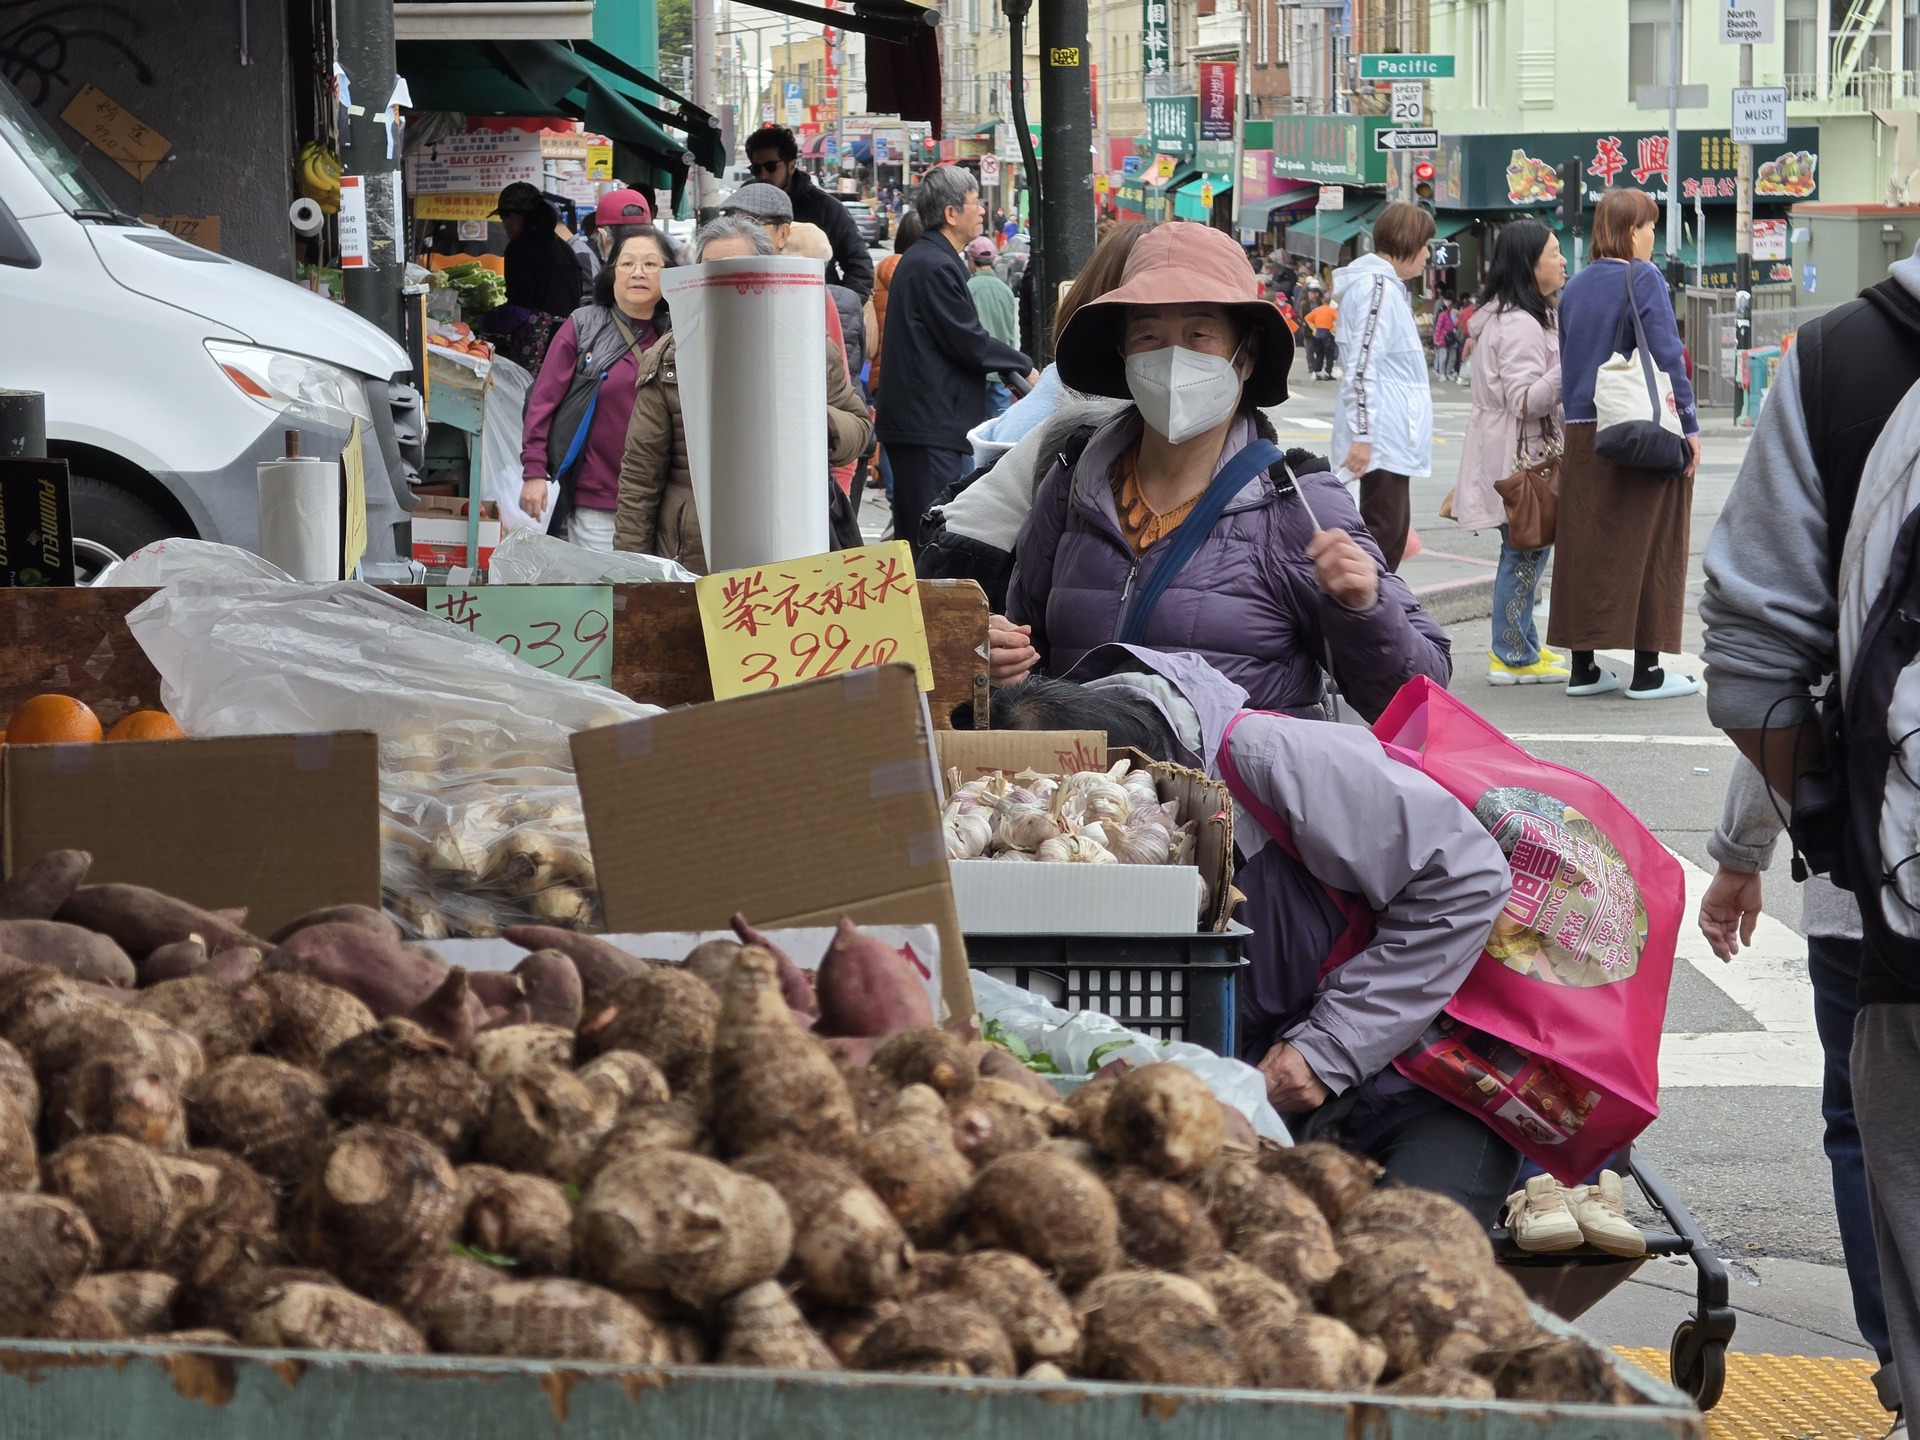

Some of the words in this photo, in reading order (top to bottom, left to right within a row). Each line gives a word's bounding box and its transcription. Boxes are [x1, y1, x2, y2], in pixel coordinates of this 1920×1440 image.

[1727, 10, 1755, 19] North
[1727, 19, 1758, 29] Beach
[1727, 29, 1762, 40] Garage
[1378, 60, 1438, 73] Pacific
[1737, 95, 1756, 104] LEFT
[1761, 94, 1783, 103] LANE
[1396, 103, 1420, 117] 20
[1744, 110, 1773, 120] MUST
[1394, 135, 1412, 144] ONE
[1415, 134, 1433, 144] WAY
[1735, 127, 1756, 136] TURN
[1761, 126, 1781, 135] LEFT
[450, 155, 470, 165] BAY
[473, 155, 507, 165] CRAFT
[1587, 135, 1669, 187] 華興
[1682, 177, 1738, 198] 食品公
[1372, 285, 1383, 310] TOMMY
[1364, 314, 1377, 346] HILFIGER
[1357, 347, 1369, 373] TOMMY
[1359, 407, 1367, 432] TOMMY
[38, 478, 60, 568] PUMMELO
[1537, 888, 1568, 934] HANG
[1595, 921, 1614, 947] 1050
[1608, 891, 1619, 919] Grant
[1555, 909, 1587, 951] 燕窩
[1601, 949, 1618, 969] San
